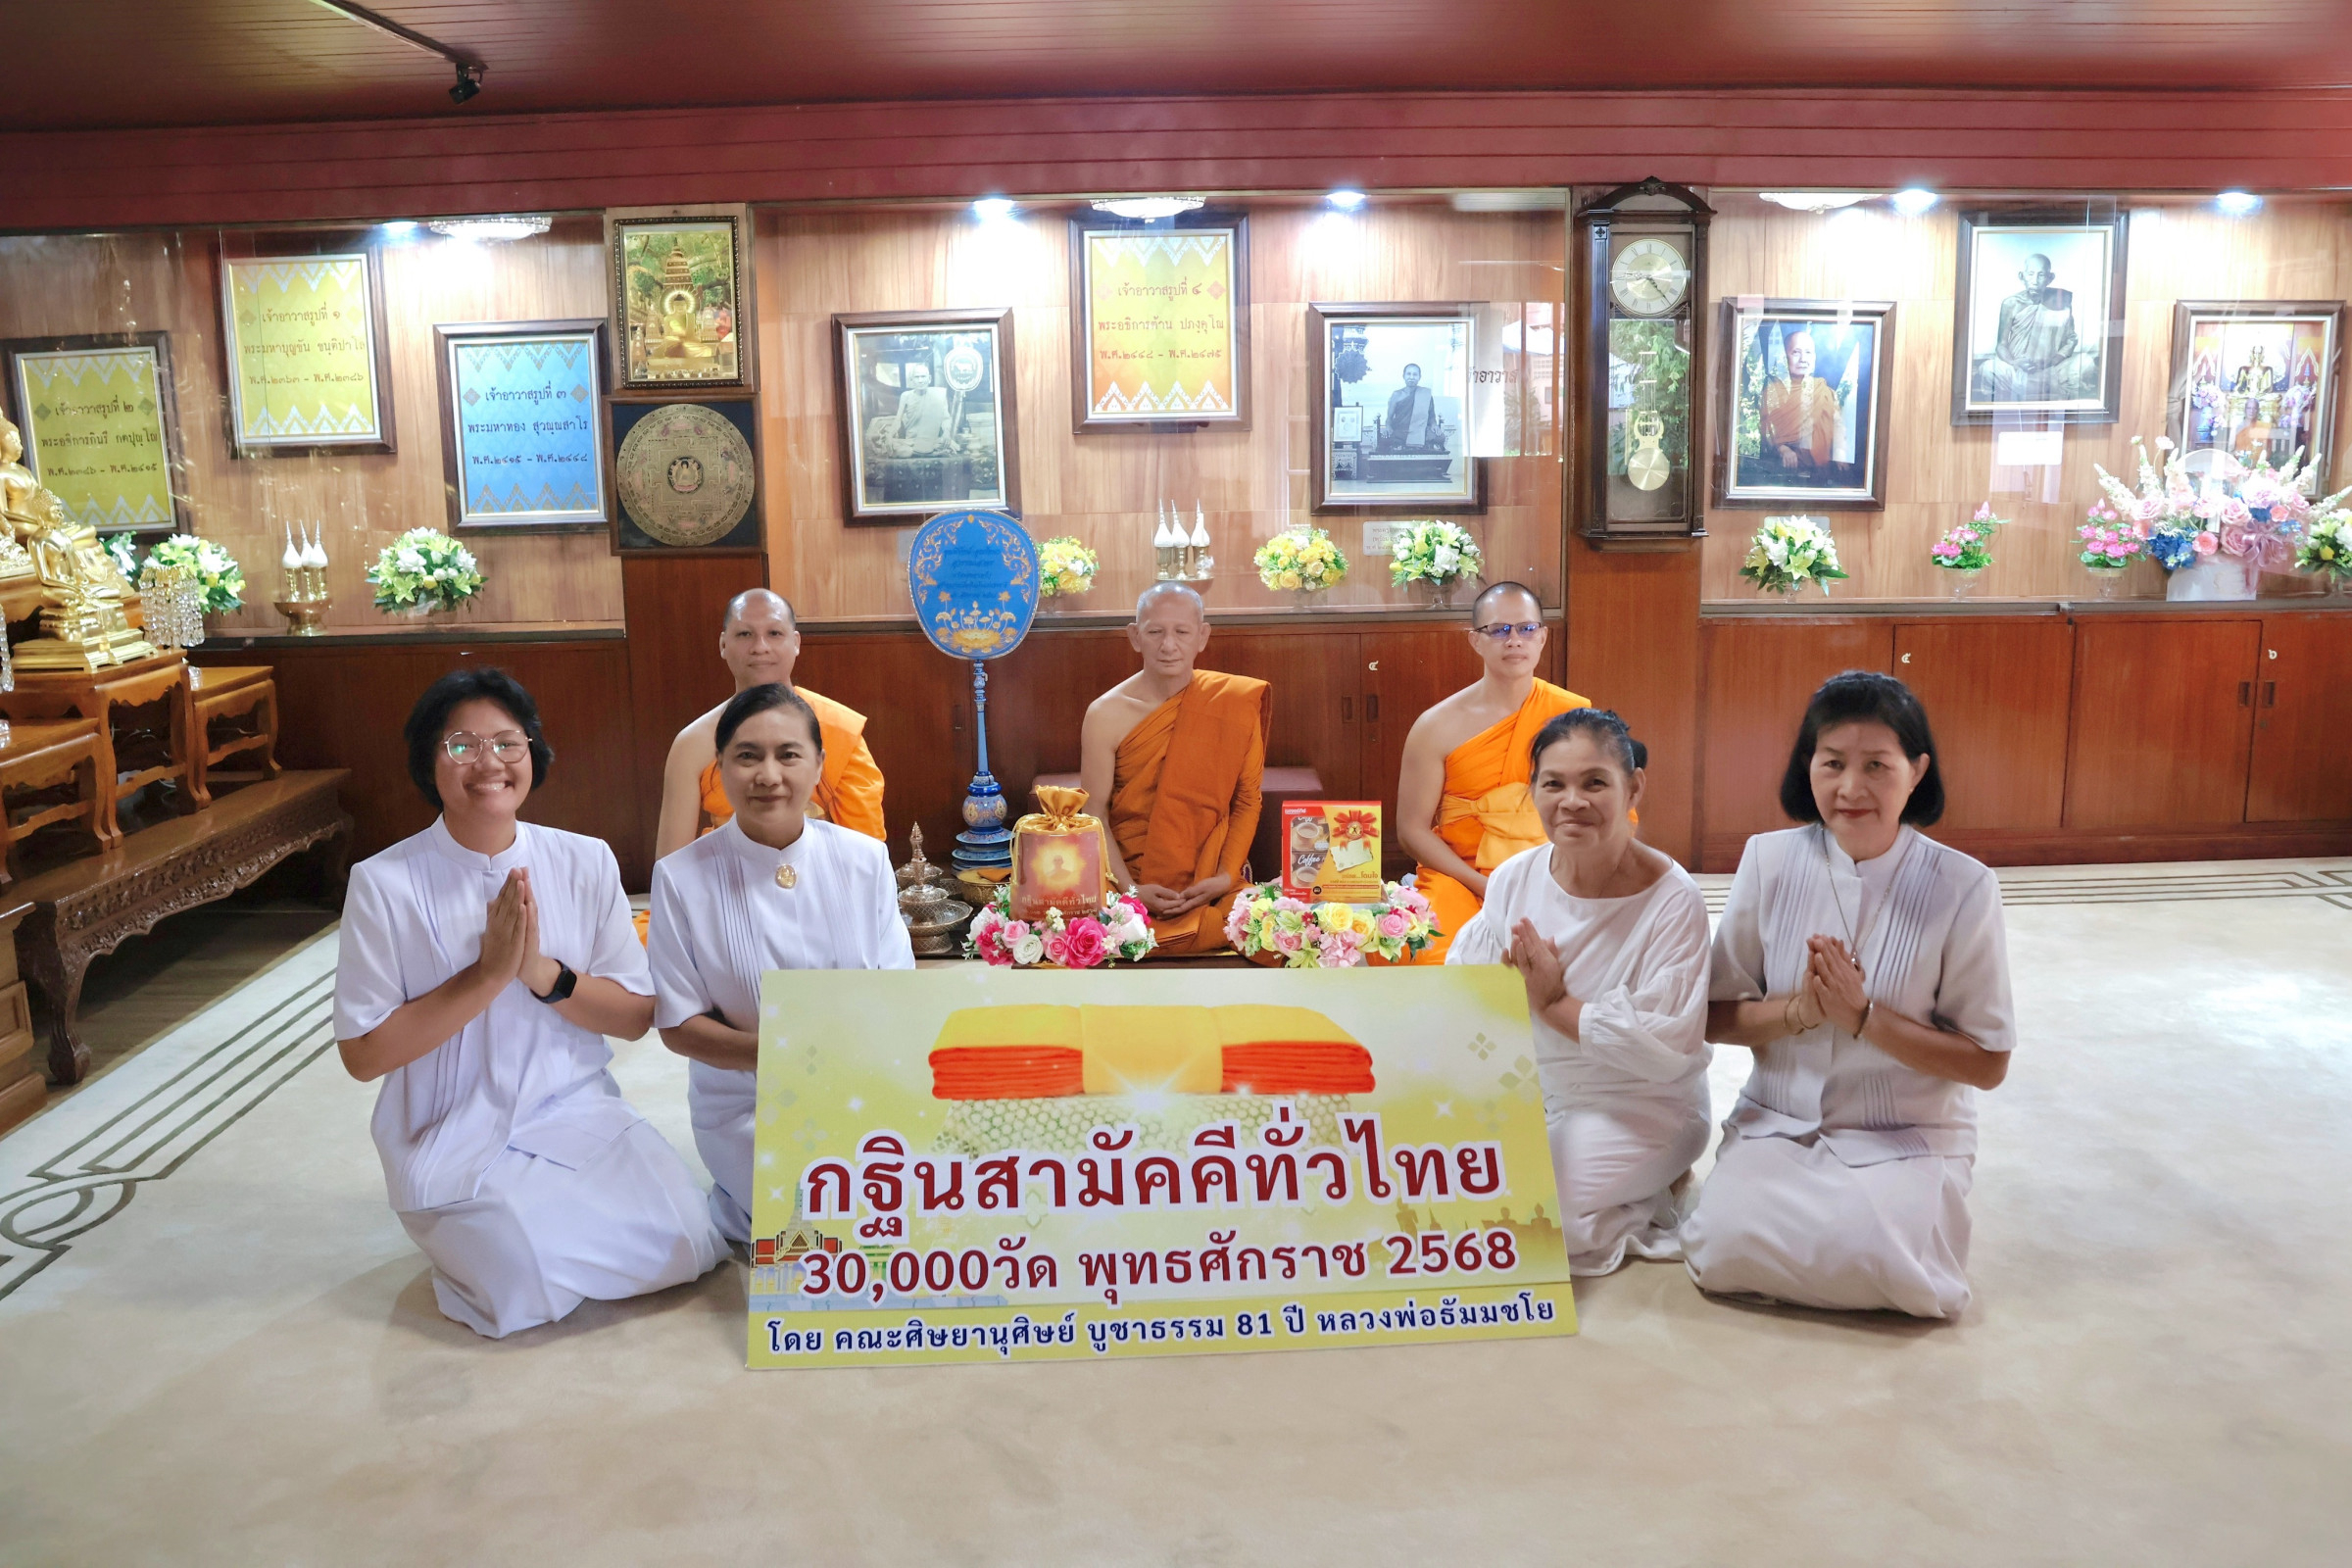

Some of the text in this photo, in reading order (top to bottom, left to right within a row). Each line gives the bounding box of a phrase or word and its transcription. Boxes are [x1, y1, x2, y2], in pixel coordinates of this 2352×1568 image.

[1117, 275, 1202, 302] เจ้าอาวาสรูปที่ ๔
[262, 301, 328, 326] เจ้าอาวาสรูปที่
[485, 379, 553, 406] เจ้าอาวาสรูปที่
[1298, 853, 1320, 867] Coffee
[807, 1106, 1500, 1239] กฐินสามัคคีทั่วไทย
[803, 1229, 1518, 1306] 30,000วัด พุทธศักราช 2568
[767, 1292, 1555, 1357] โดย คณะศิษยานุศิษย์ บูชาธรรม 81 ปี หลวงพ่อธัมมชโย
